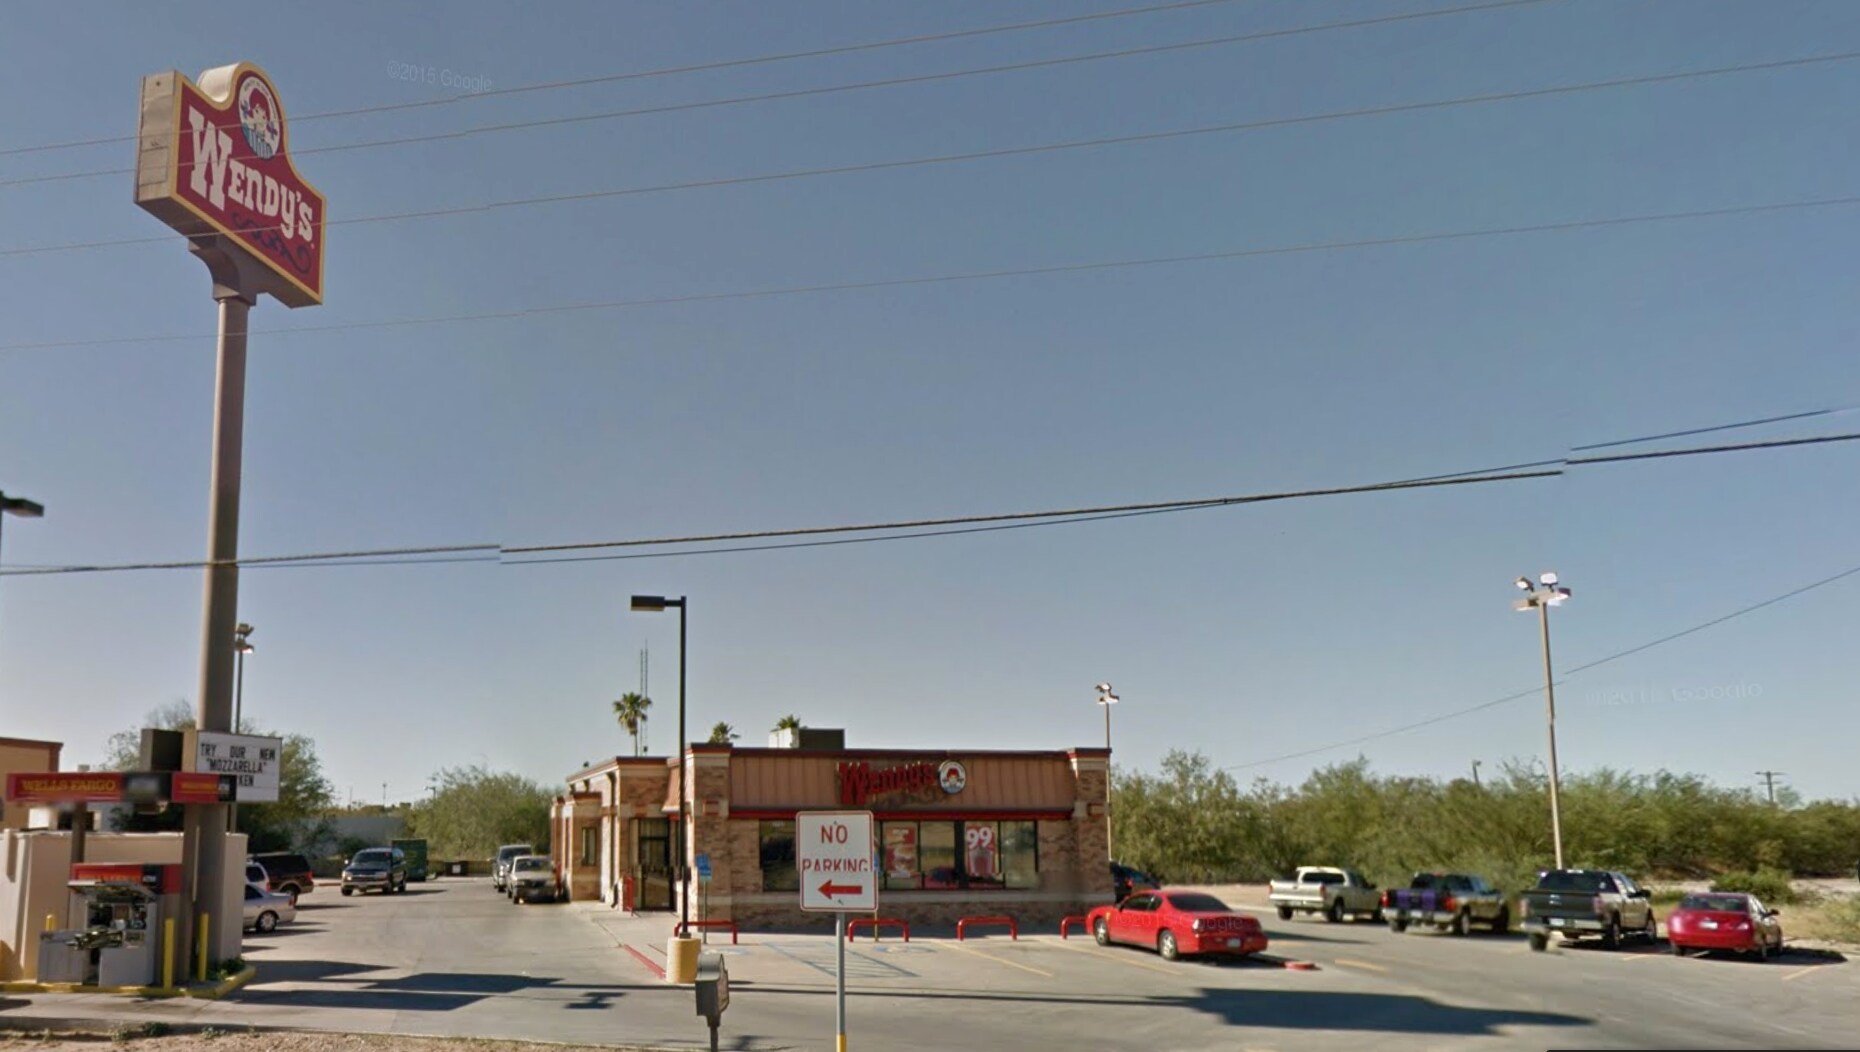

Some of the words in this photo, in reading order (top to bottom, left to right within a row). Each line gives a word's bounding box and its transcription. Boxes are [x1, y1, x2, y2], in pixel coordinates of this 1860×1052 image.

[201, 743, 216, 756] TRY
[230, 745, 246, 759] OUR
[22, 779, 68, 792] WELLS
[69, 779, 116, 792] FARGO
[821, 824, 848, 844] NO
[966, 827, 993, 849] 99
[802, 858, 869, 873] PARKING
